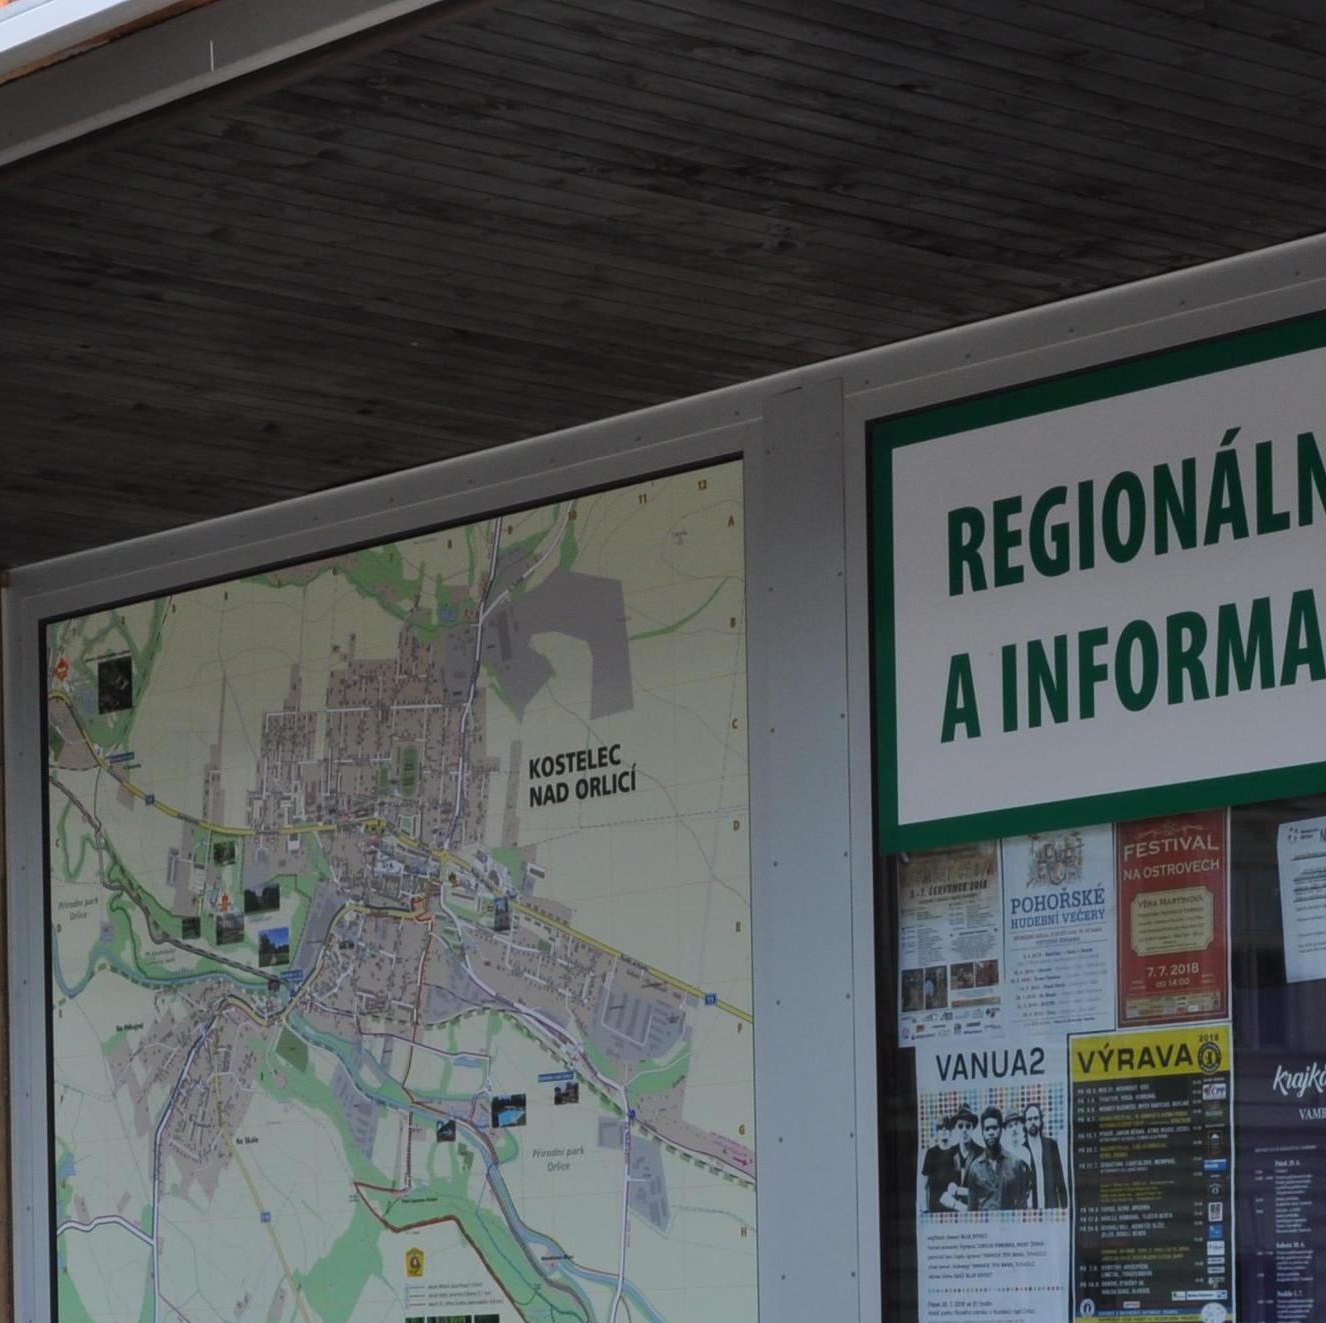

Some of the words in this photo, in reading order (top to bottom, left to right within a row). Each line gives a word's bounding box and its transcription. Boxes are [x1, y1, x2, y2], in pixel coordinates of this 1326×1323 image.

[940, 653, 981, 744] A
[529, 744, 621, 780] KOSTELEC
[529, 782, 570, 808] NAD
[575, 762, 637, 800] ORLICÍ
[1124, 835, 1219, 862] FESTIVAL
[1124, 869, 1140, 881] NA
[1144, 860, 1219, 879] OSTROVECH
[1010, 882, 1105, 915] POHOŘSKÉ
[1011, 914, 1059, 929] HUDEBNÍ
[1062, 909, 1105, 925] VEČERY
[1171, 963, 1199, 975] 2018
[935, 1046, 1046, 1082] VANUA2
[1077, 1042, 1193, 1073] VÝRAVA
